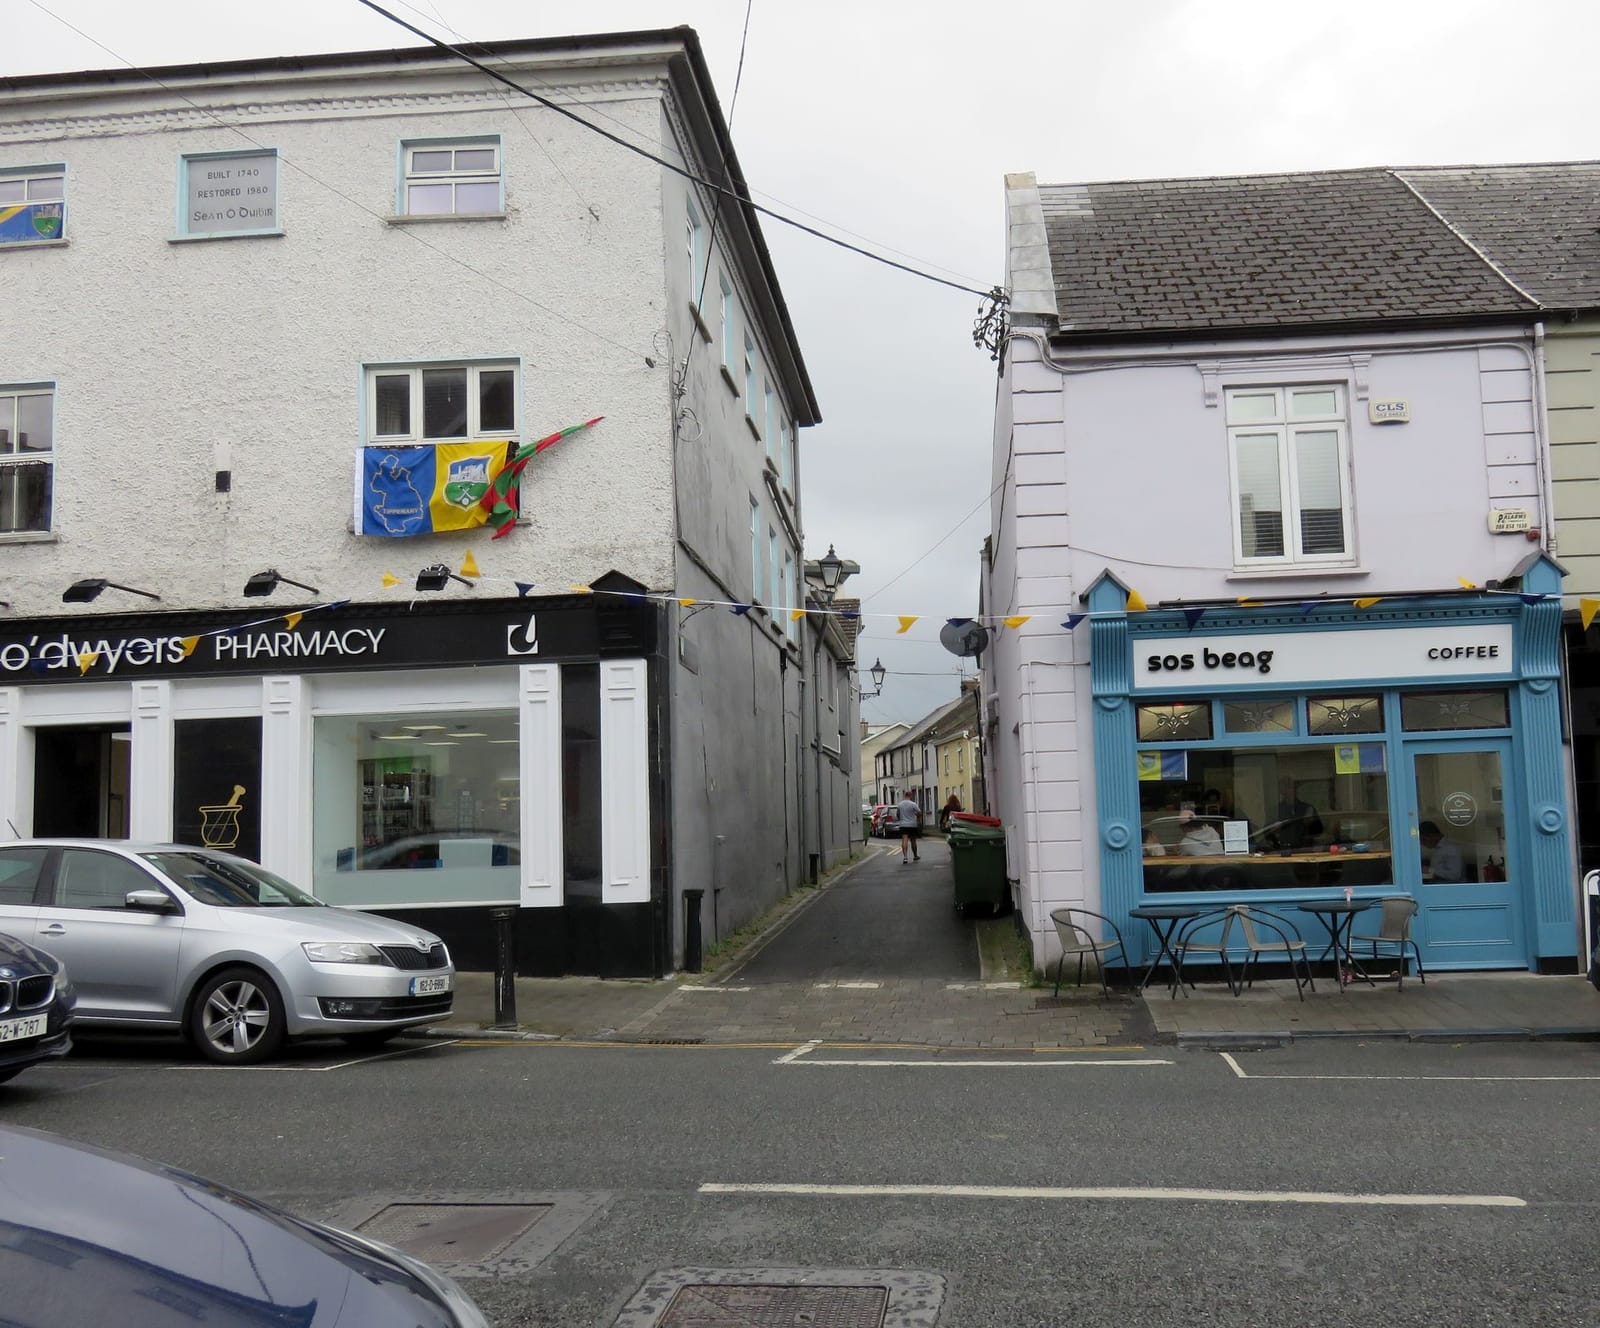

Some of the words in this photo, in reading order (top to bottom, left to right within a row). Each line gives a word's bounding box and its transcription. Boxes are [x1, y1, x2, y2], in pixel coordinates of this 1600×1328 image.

[208, 170, 232, 179] BUILT
[237, 168, 260, 177] 1740
[198, 187, 241, 199] RESTORED
[1376, 403, 1404, 412] CLS
[214, 628, 386, 660] PHARMACY
[1428, 645, 1499, 660] COFFEE
[1147, 652, 1195, 672] sos
[1203, 647, 1274, 674] beag
